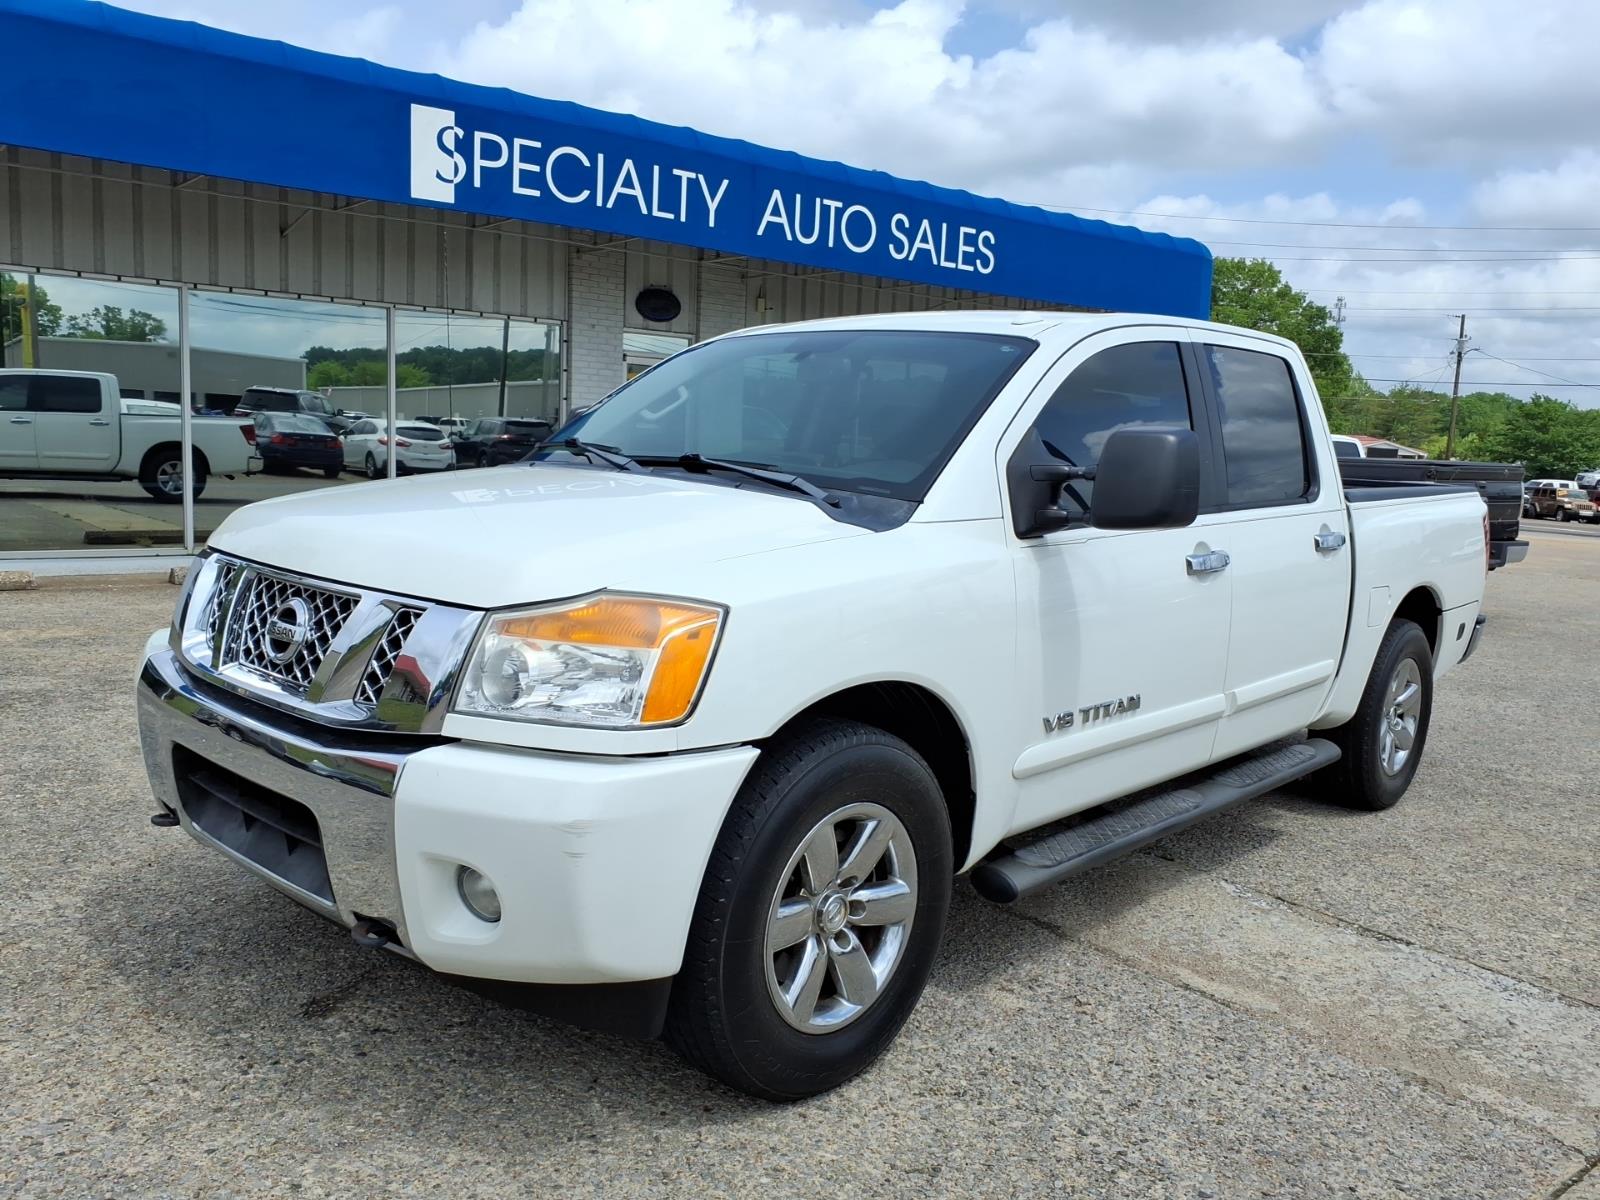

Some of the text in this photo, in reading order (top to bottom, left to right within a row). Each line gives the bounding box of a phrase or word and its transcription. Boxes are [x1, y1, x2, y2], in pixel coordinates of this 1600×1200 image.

[434, 125, 996, 276] SPECIALTY AUTO SALES
[268, 621, 297, 639] SSAN
[1042, 693, 1141, 734] V8 TITAN
